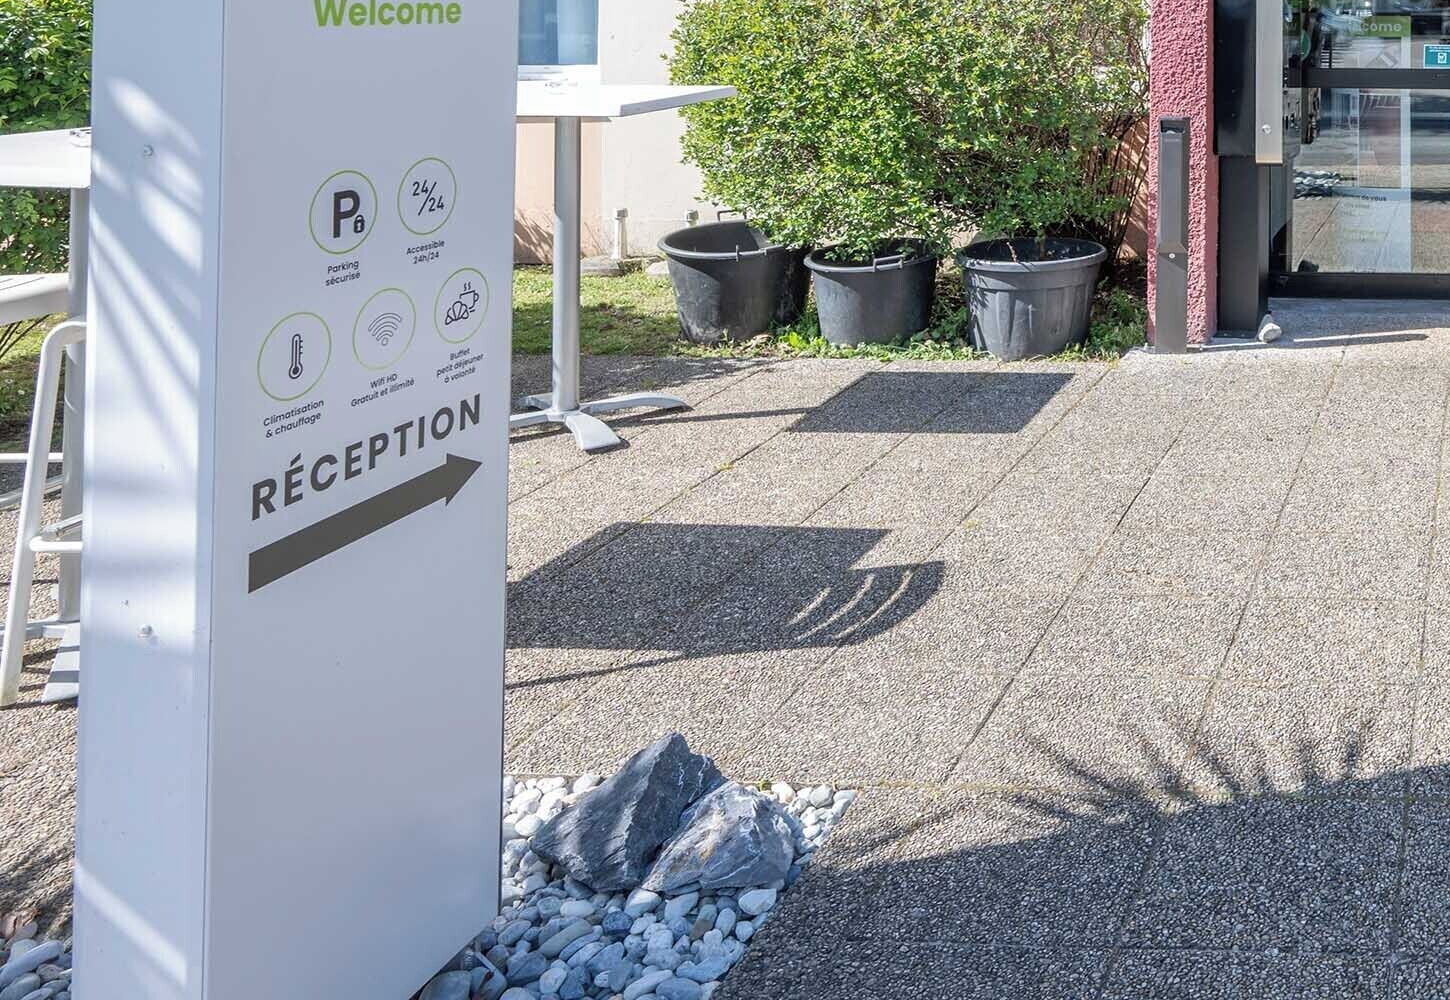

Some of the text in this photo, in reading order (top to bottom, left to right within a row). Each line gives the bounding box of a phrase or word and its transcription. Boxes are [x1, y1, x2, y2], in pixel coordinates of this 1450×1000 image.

[333, 189, 360, 239] P
[406, 240, 445, 255] Accessible
[413, 251, 440, 265] 24h/24
[327, 260, 360, 275] Parking
[325, 271, 361, 287] sécurisé
[450, 347, 470, 361] Buffet
[370, 373, 398, 389] Wifi HD
[451, 366, 476, 381] volonté
[351, 377, 415, 407] Gratuit et illimité
[263, 400, 324, 427] Climatisation
[265, 412, 321, 439] & chauffage
[251, 393, 481, 521] RÉCEPTION
